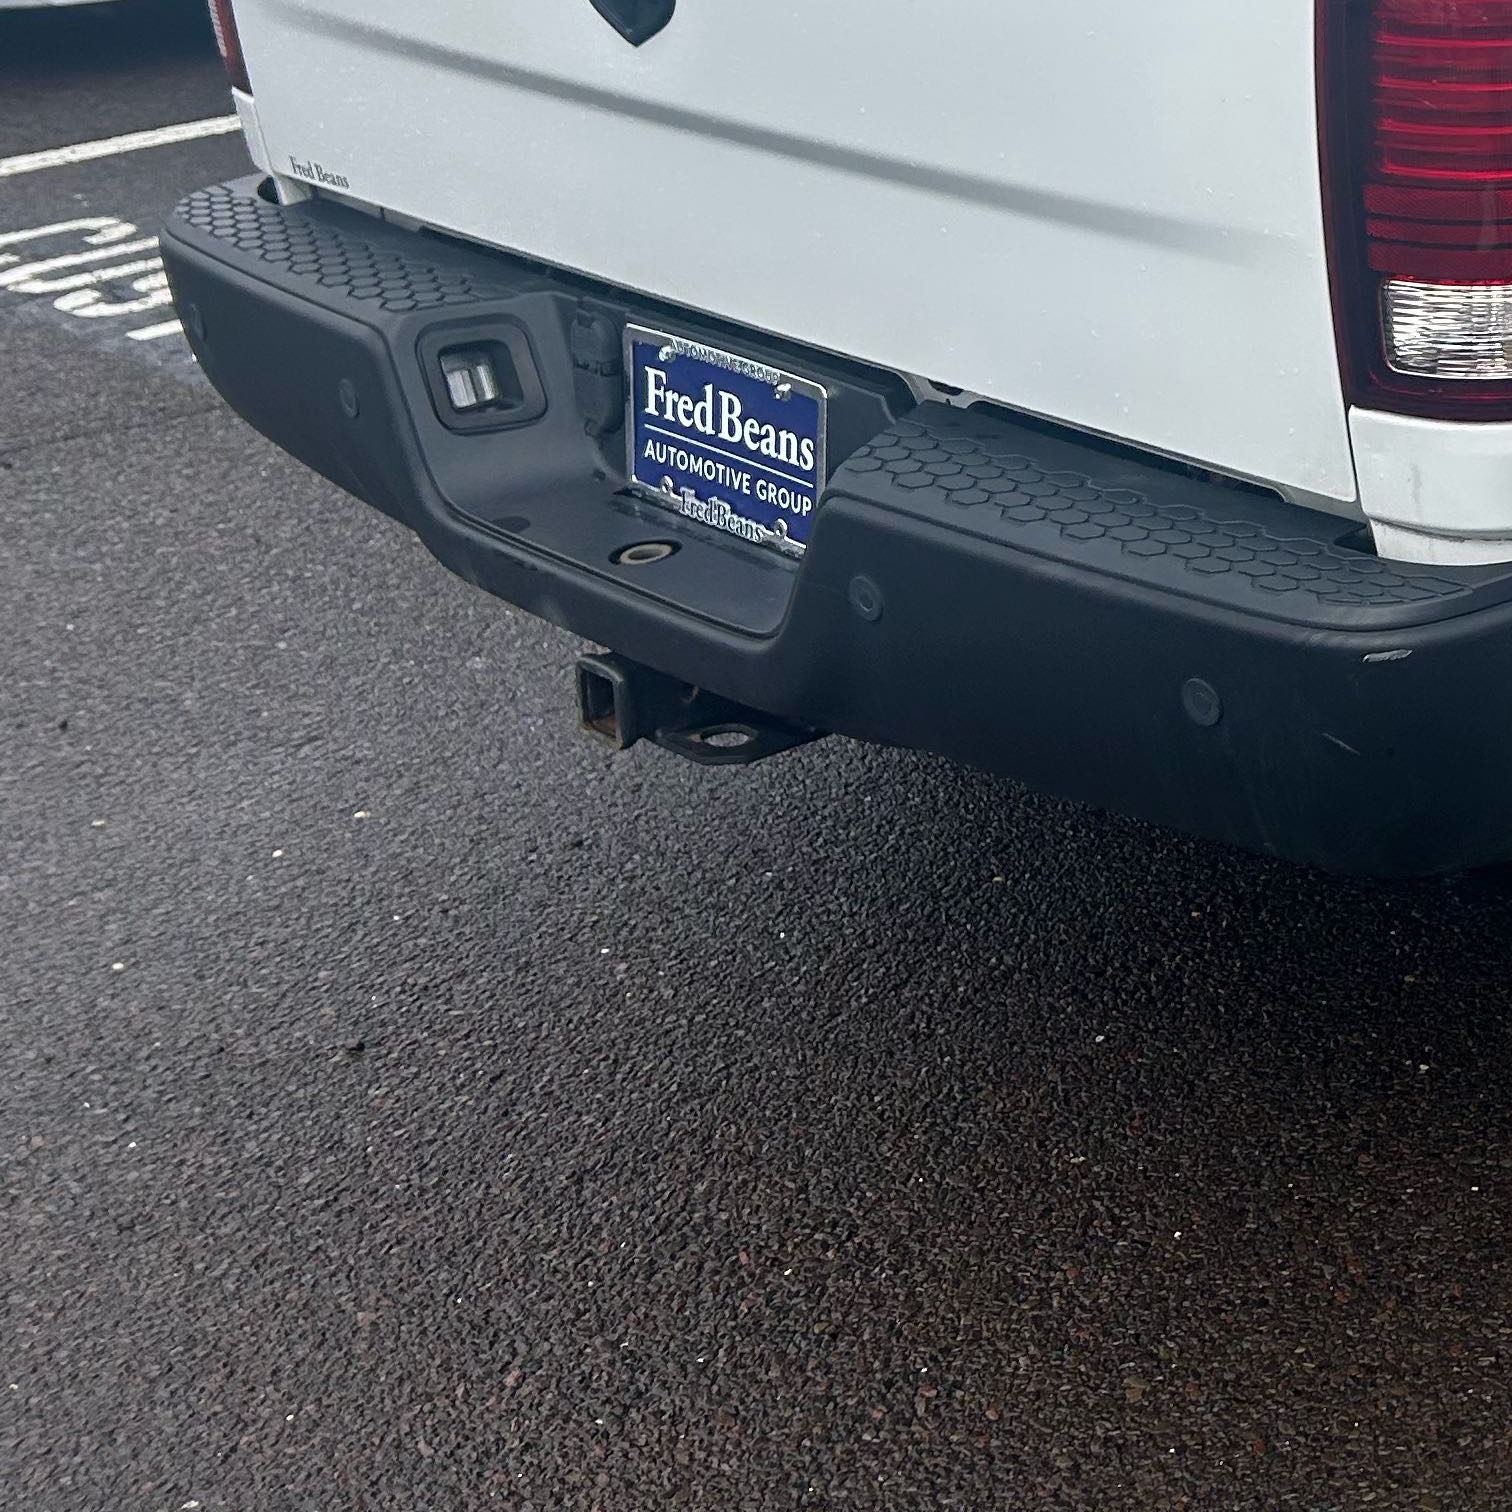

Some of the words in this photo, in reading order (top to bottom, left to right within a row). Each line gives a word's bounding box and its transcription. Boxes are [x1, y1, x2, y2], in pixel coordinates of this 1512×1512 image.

[288, 154, 315, 179] Fred
[314, 162, 350, 189] Beans
[644, 366, 716, 436] Fred
[718, 389, 815, 471] Beans
[644, 439, 751, 495] AUTOMOTIVE
[756, 479, 813, 517] GROUP
[679, 486, 717, 525] Fred
[715, 498, 766, 543] Beans
